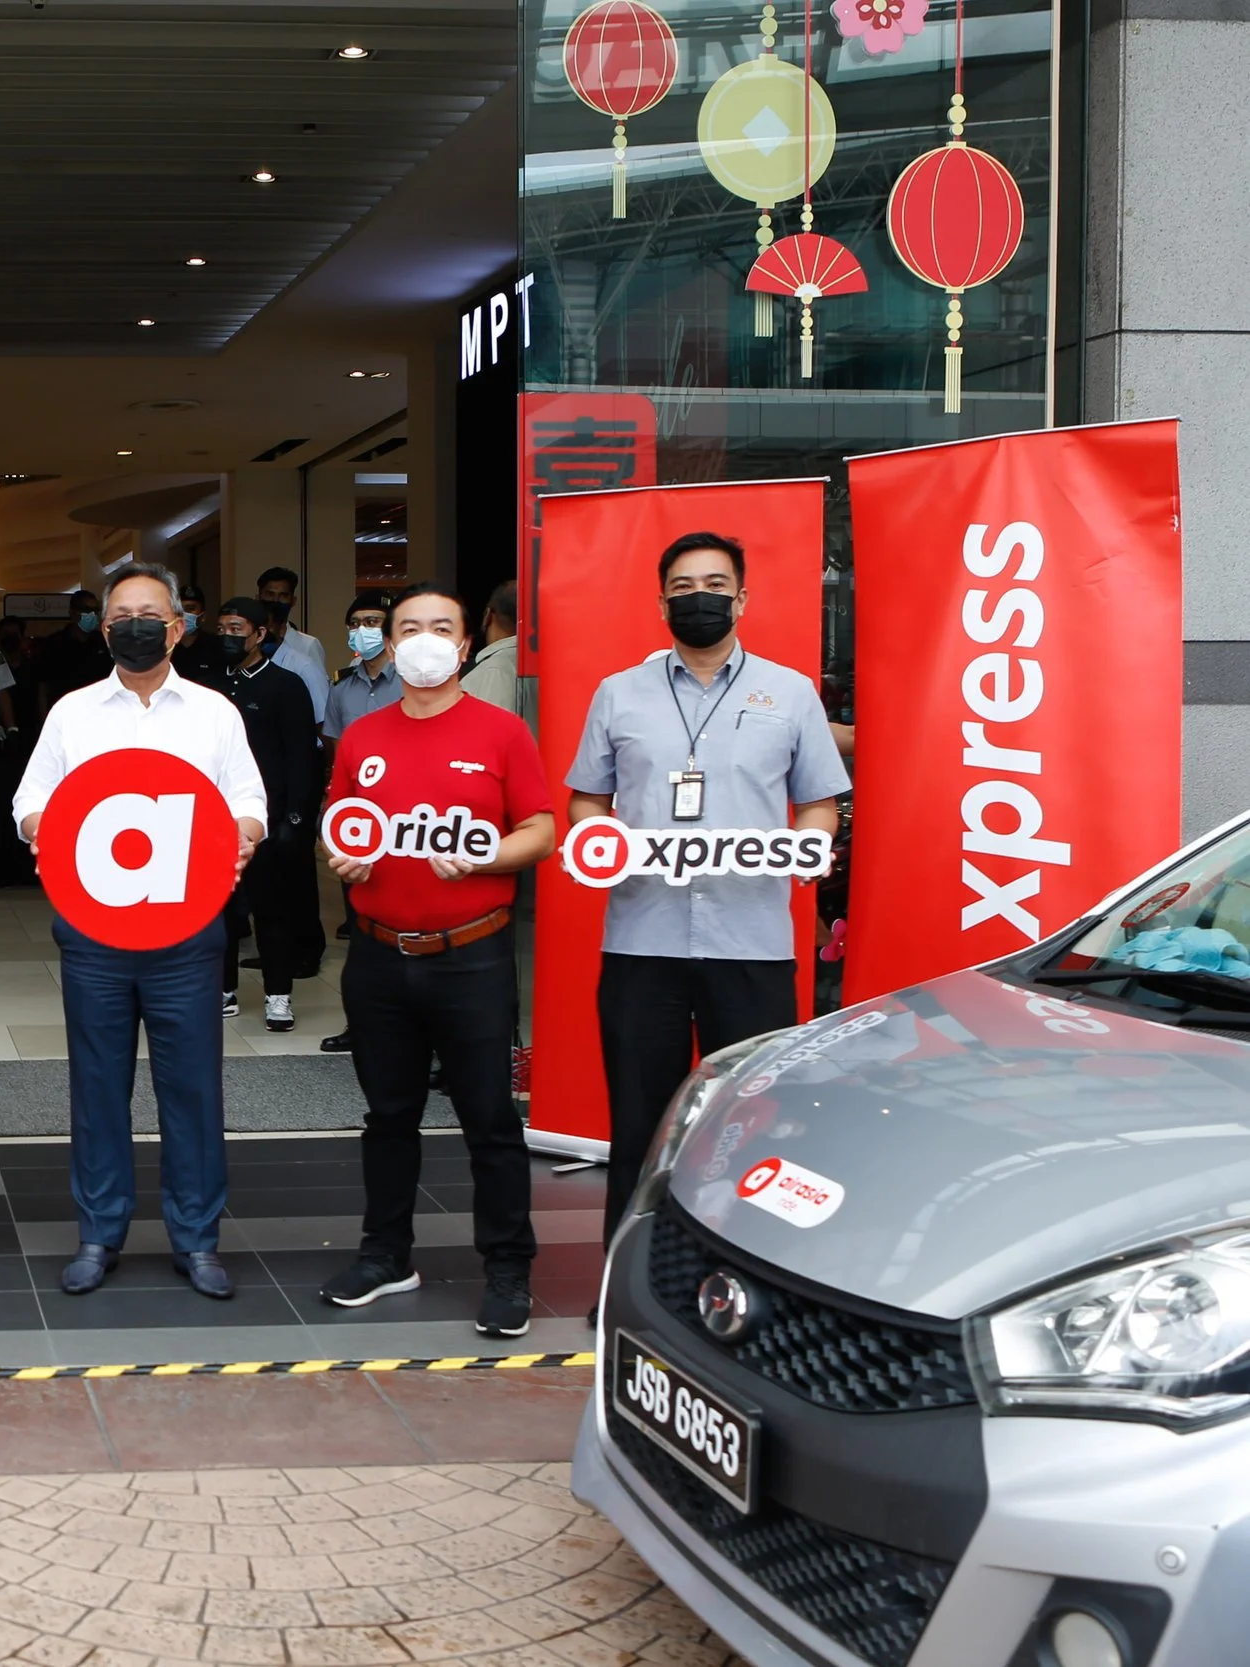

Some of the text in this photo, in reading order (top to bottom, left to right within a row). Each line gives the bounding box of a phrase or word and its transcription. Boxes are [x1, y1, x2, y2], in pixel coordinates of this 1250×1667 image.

[960, 521, 1071, 943] xpress
[75, 793, 196, 907] a
[394, 812, 491, 857] ride
[642, 837, 822, 878] xpress
[778, 1176, 830, 1205] airasia
[626, 1354, 740, 1477] JSB 6853
